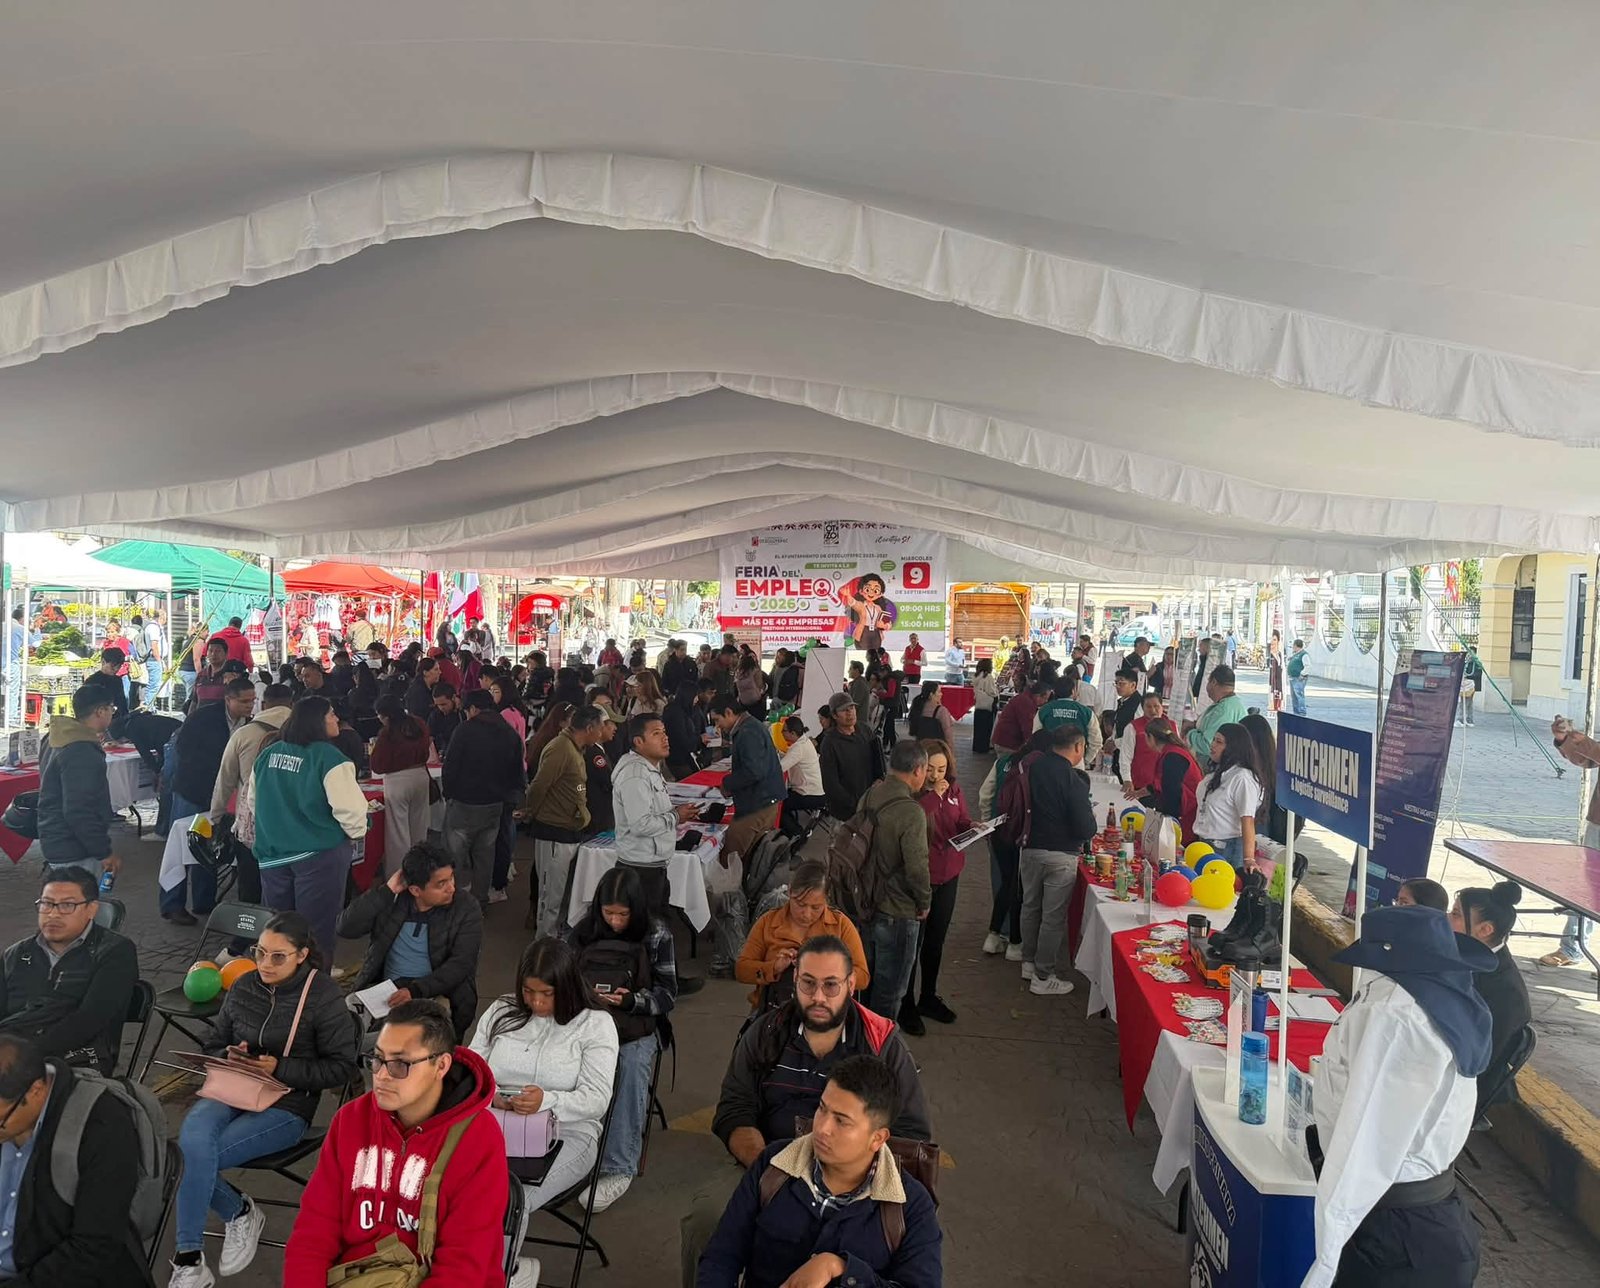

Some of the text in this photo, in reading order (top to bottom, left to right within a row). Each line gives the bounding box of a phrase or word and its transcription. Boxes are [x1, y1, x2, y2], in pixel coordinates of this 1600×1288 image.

[735, 566, 777, 577] FERIA
[910, 567, 924, 584] 9
[760, 599, 796, 610] 2026
[743, 616, 760, 625] MÁS
[1053, 708, 1078, 719] UNIVERSITY
[269, 753, 304, 773] UNIVERSITY
[1285, 732, 1359, 799] WATCHMEN
[1314, 786, 1349, 813] surveillance
